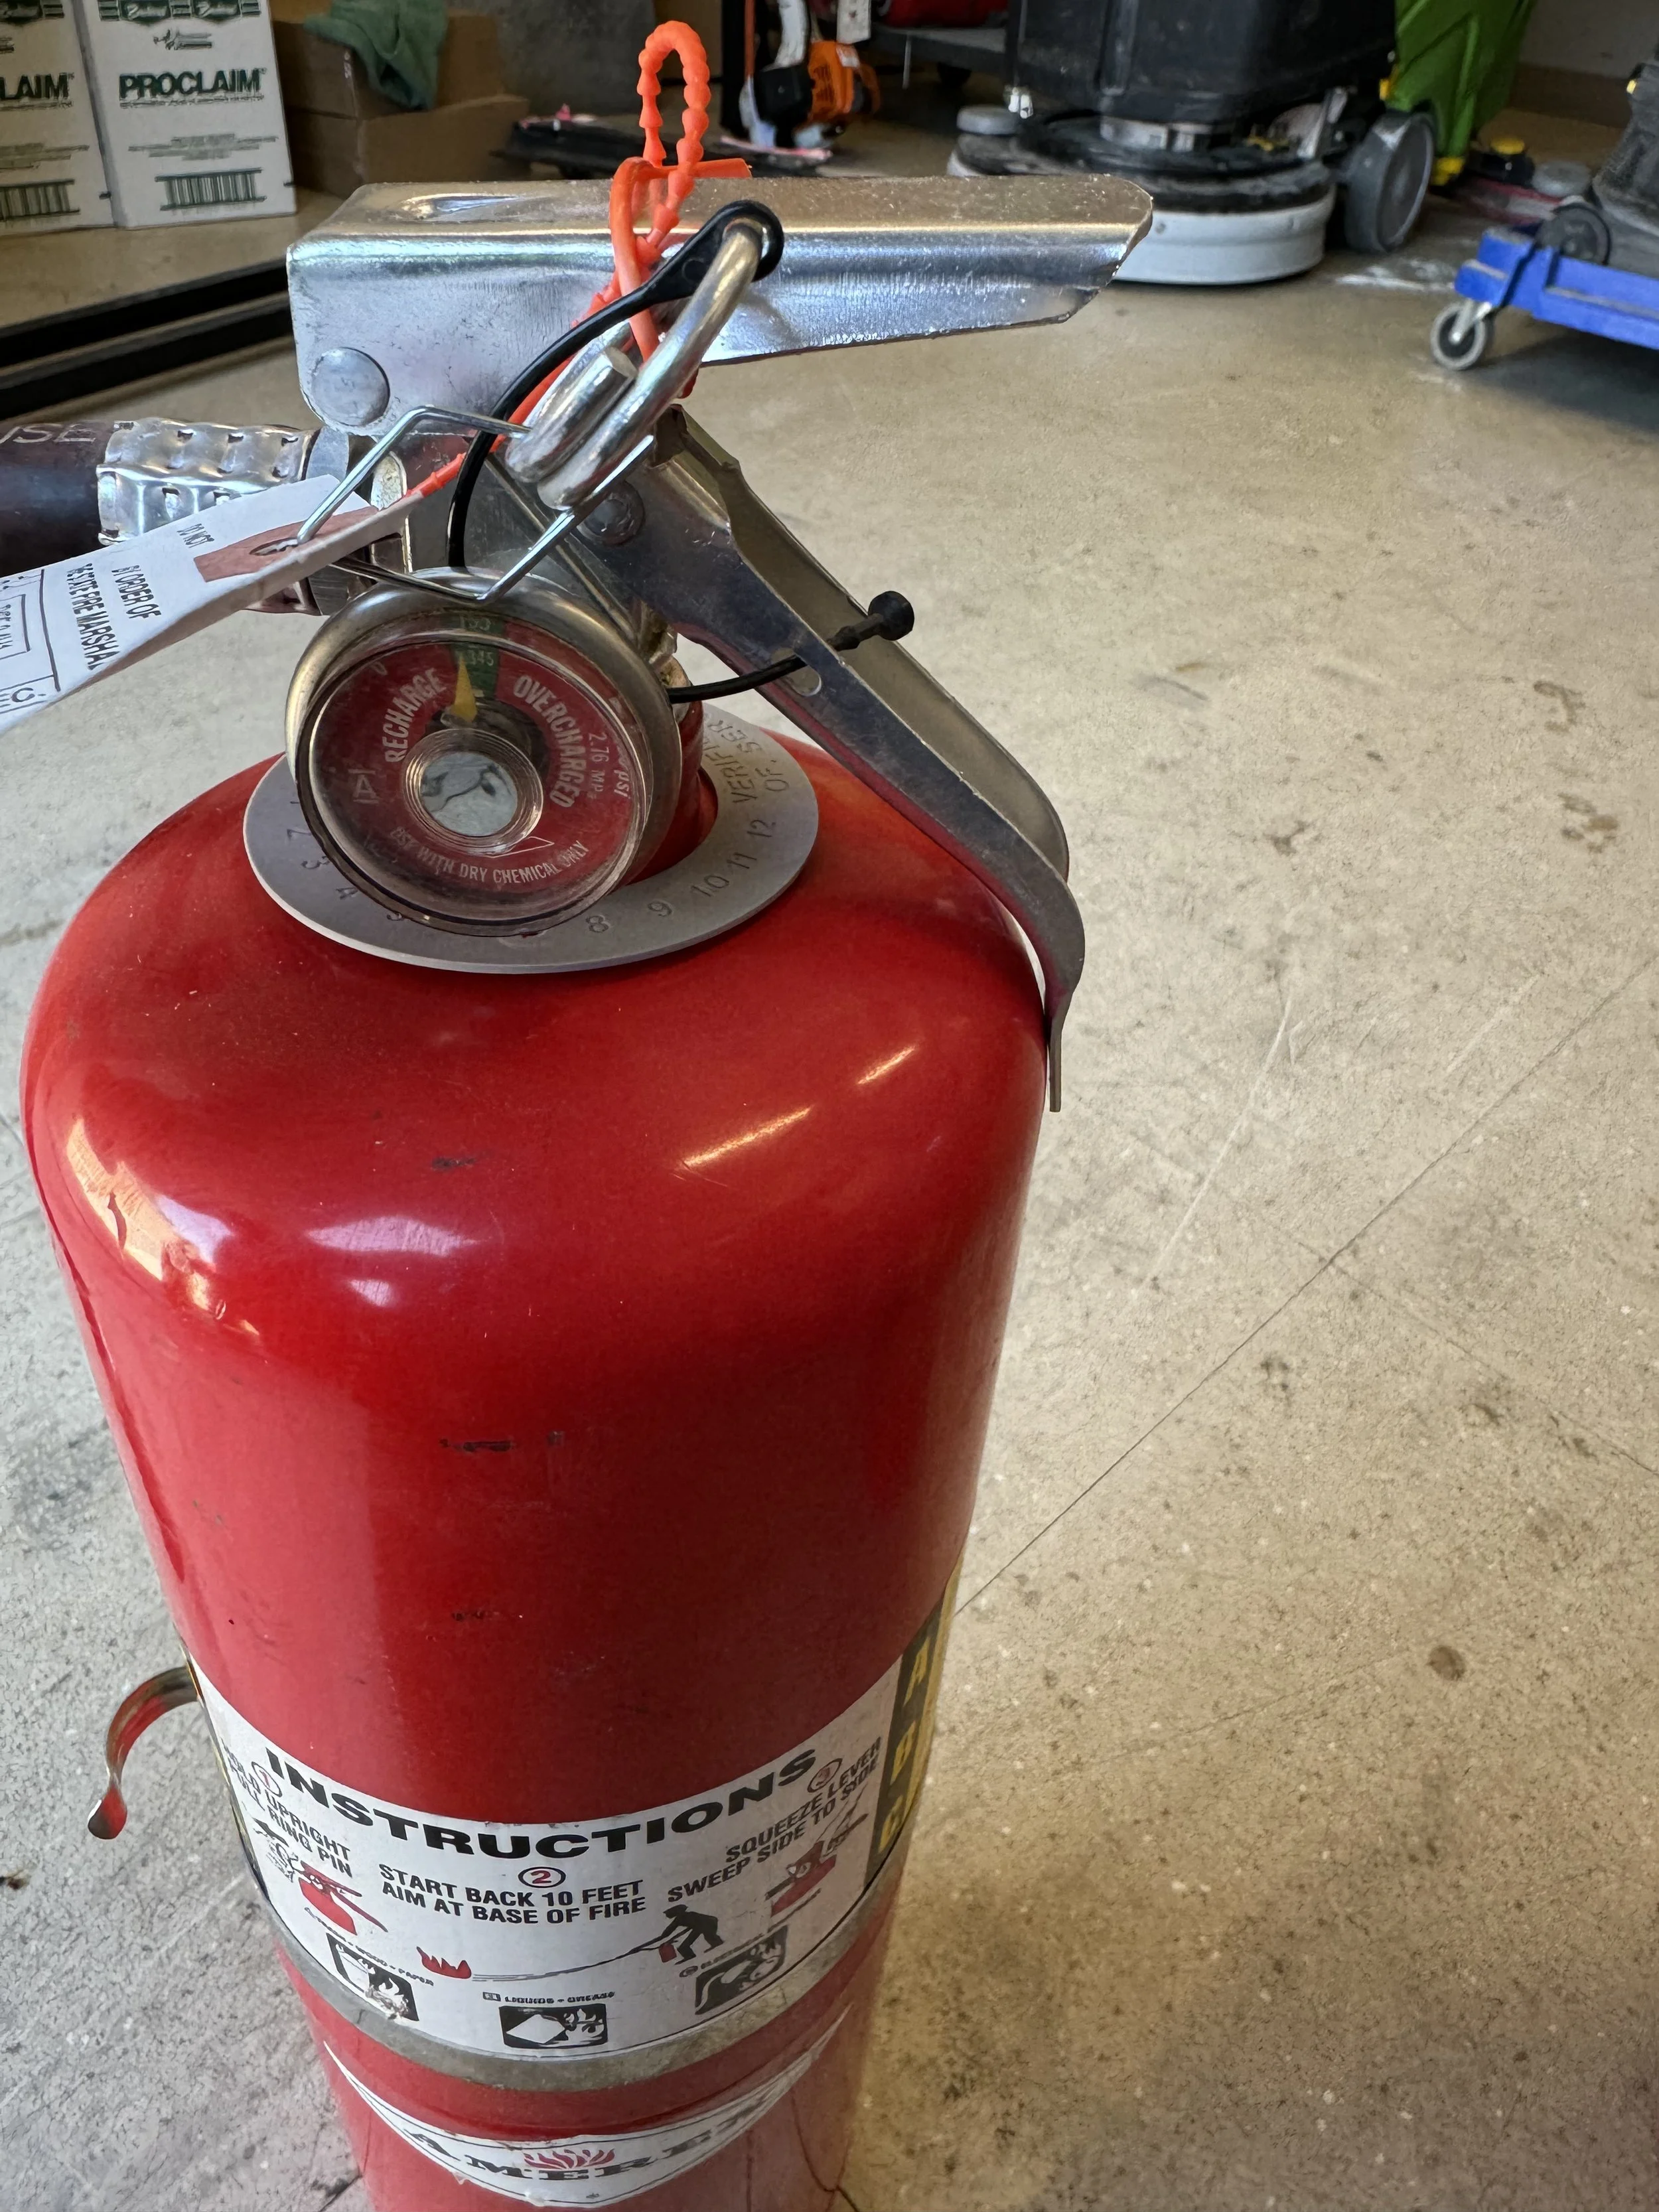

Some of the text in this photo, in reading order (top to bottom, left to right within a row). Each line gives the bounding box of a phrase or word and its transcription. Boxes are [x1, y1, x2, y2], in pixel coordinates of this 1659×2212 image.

[119, 68, 261, 99] PROCLAIM
[70, 591, 105, 615] FIRE
[115, 573, 155, 607] ORDER
[125, 603, 162, 619] OF
[382, 667, 447, 763] RECHARGE
[513, 675, 587, 808] OVERCHARGED
[459, 863, 488, 883] DRY
[492, 861, 559, 885] CHEMICAL
[585, 819, 776, 934] 8 9 10 11 12
[265, 1746, 816, 1860] INSTRUCTIONS
[265, 1789, 351, 1861] UPRIGHT
[725, 1736, 881, 1863] SQUEEZE LEVER
[267, 1805, 313, 1853] RING
[317, 1846, 353, 1879] PIN
[668, 1856, 750, 1903] SWEEP
[757, 1820, 807, 1864] SIDE
[378, 1863, 644, 1907] START BACK 10 FEET
[382, 1880, 646, 1924] AIM AT BASE OF FIRE
